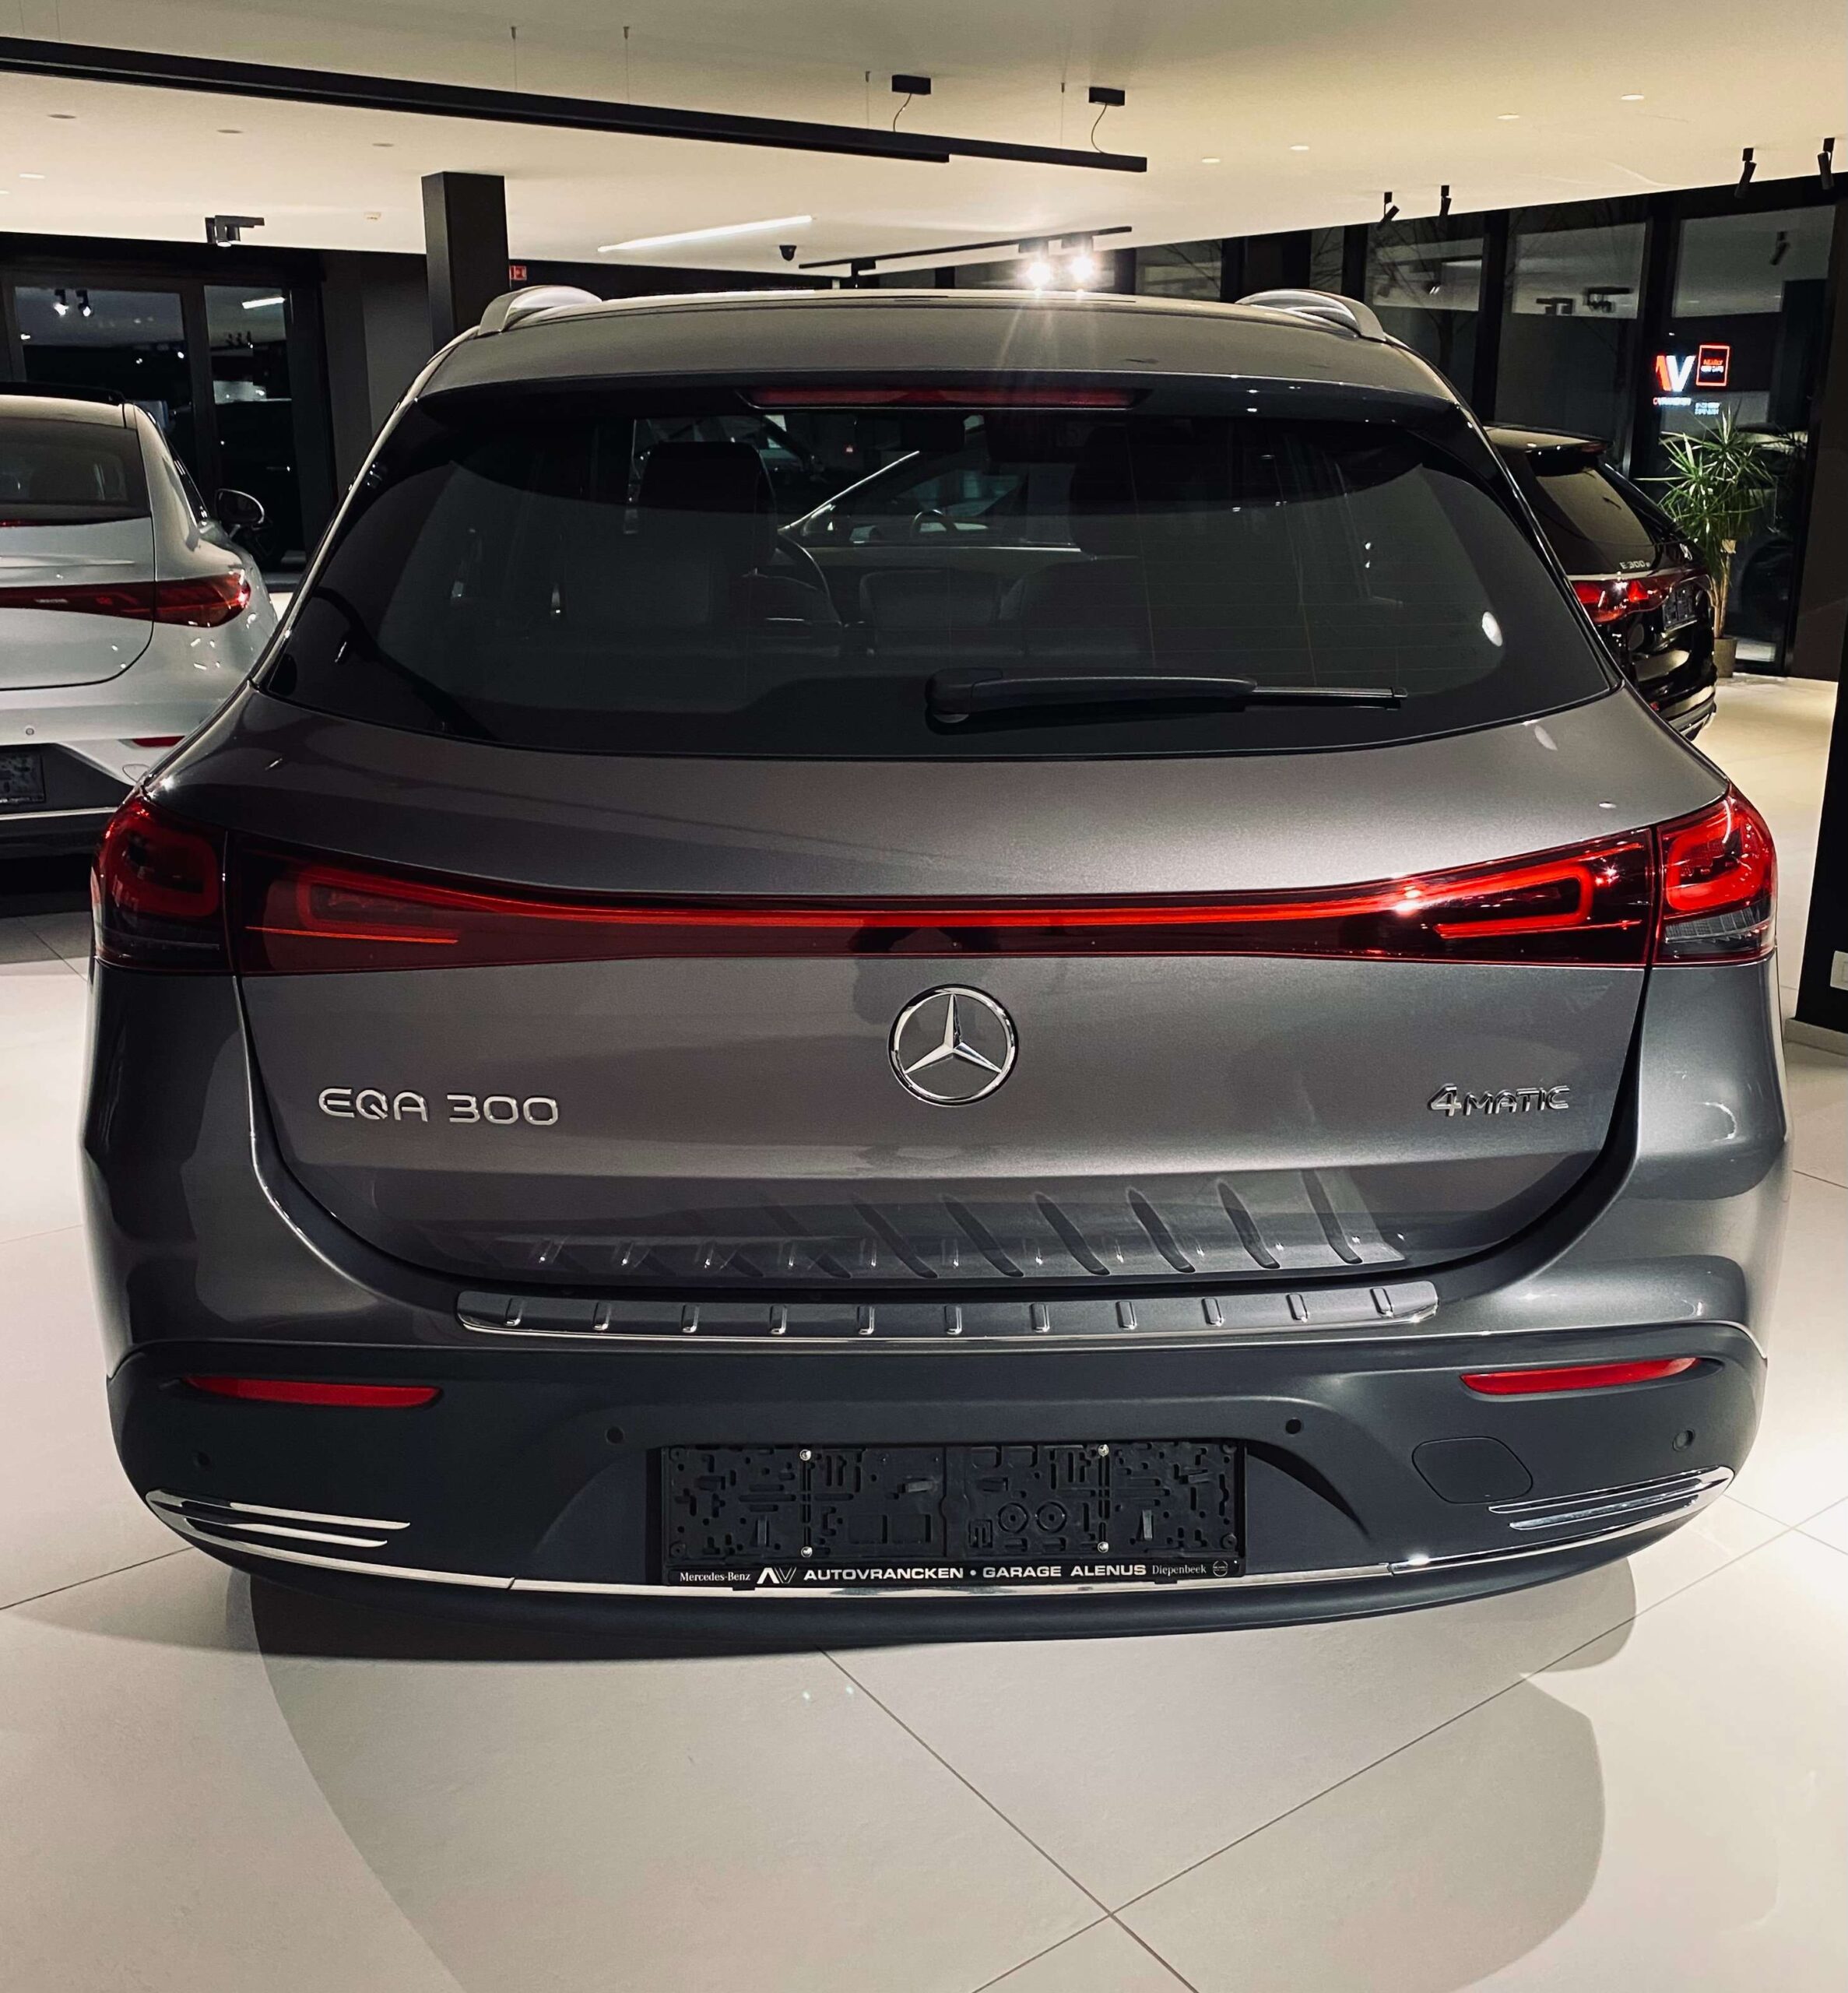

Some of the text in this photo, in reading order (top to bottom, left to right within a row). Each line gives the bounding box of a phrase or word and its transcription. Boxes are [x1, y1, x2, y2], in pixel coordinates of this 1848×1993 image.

[318, 1088, 559, 1126] EQA 300
[1428, 1083, 1570, 1116] 4MATIC
[679, 1571, 751, 1583] Mercedes-Benz
[803, 1567, 964, 1581] AUTOVRANCKEN
[982, 1566, 1062, 1579] GARAGE
[1070, 1564, 1147, 1577] ALENUS
[1152, 1563, 1207, 1576] Diepenbeek
